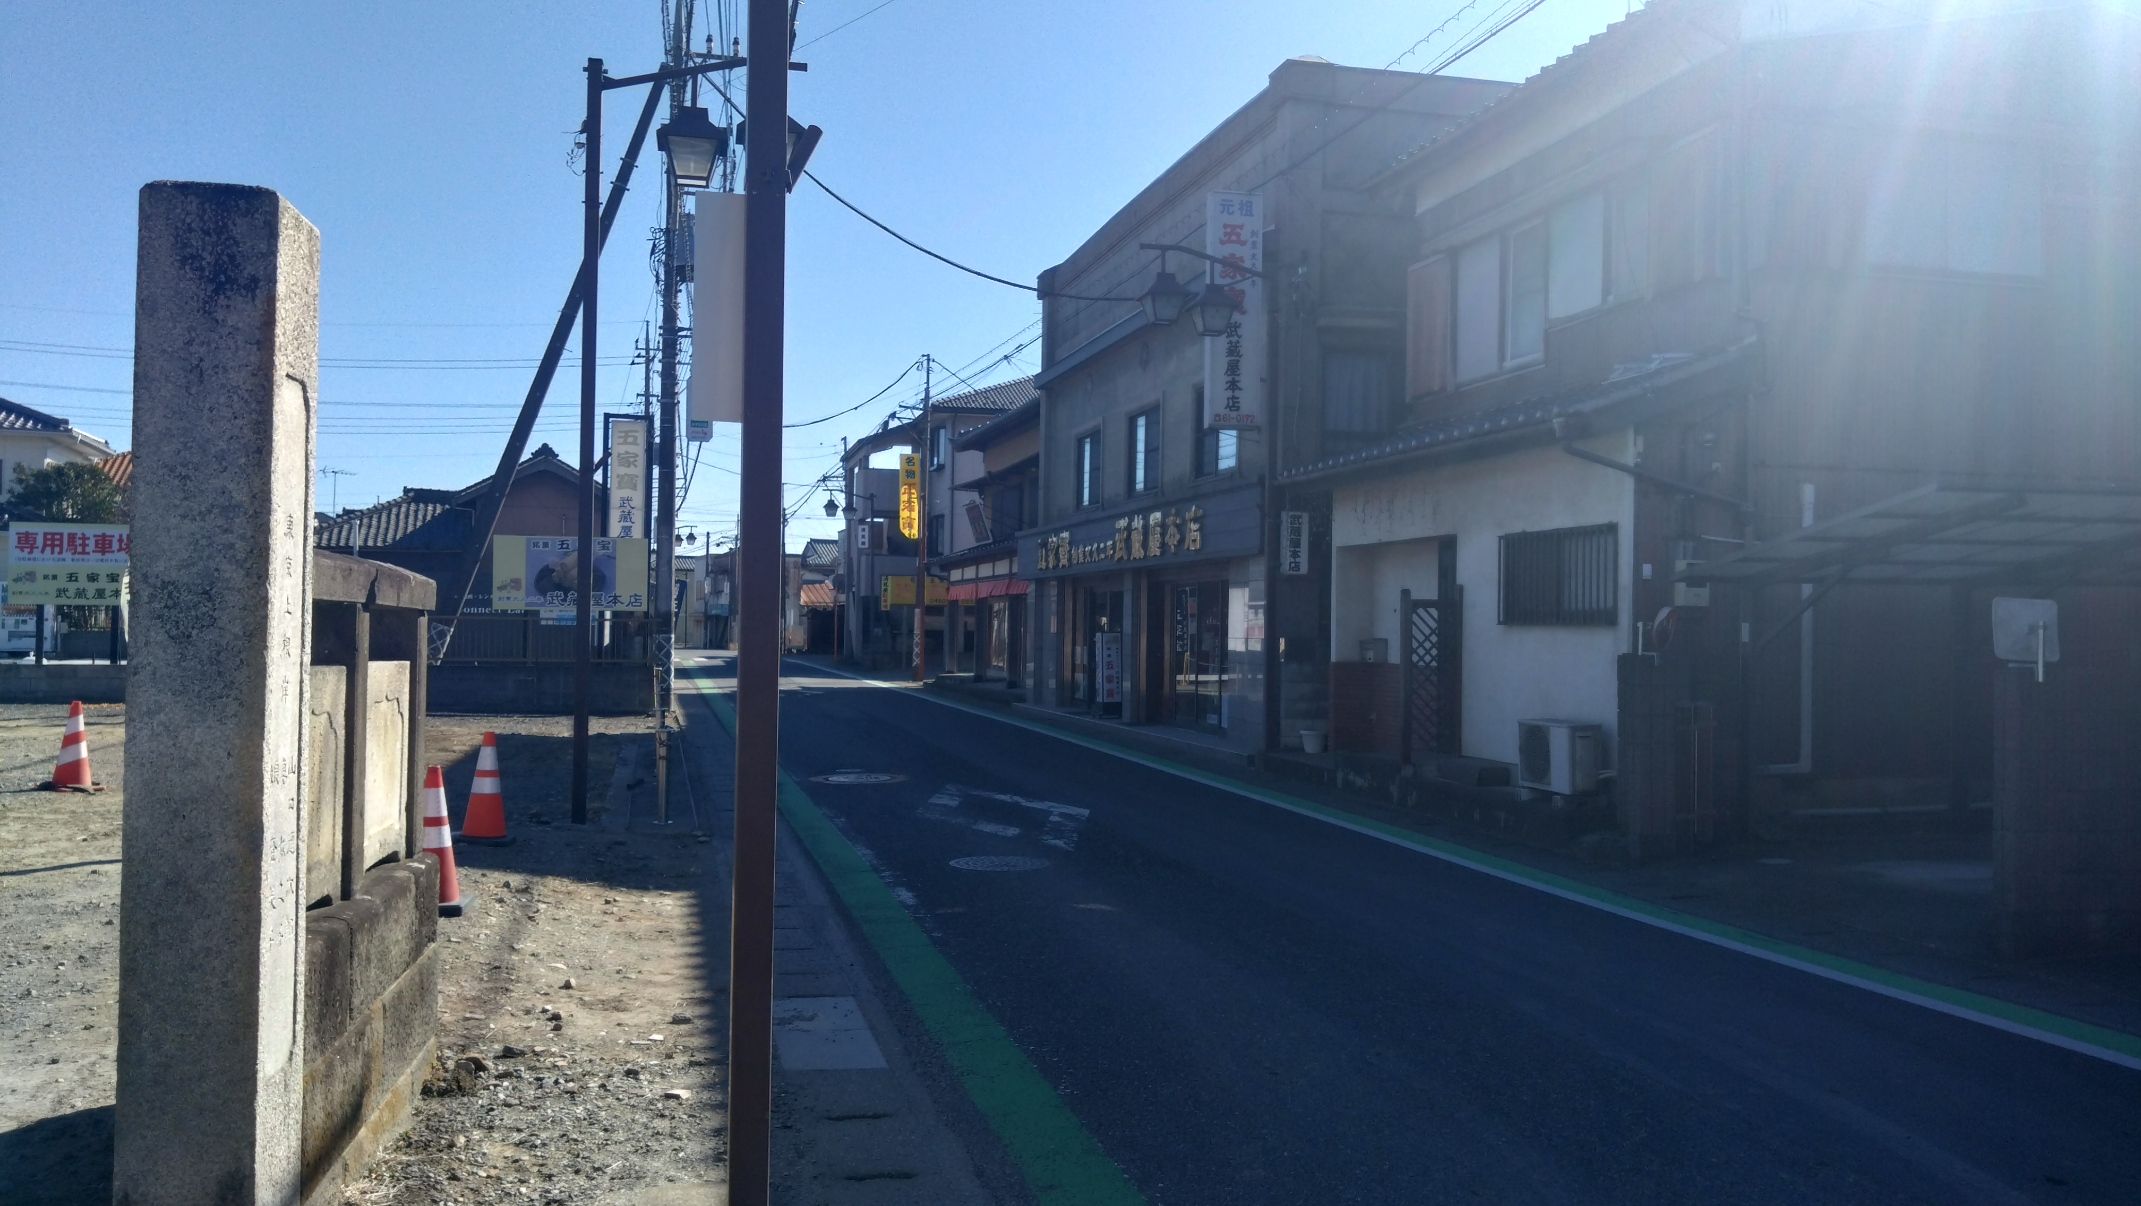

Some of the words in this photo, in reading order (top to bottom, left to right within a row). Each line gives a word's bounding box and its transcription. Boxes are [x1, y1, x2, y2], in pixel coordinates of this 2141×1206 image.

[1219, 198, 1255, 218] 元祖
[1249, 228, 1260, 289] 創業文久年
[1223, 320, 1244, 413] 武蔵屋本店
[1222, 413, 1255, 425] 61-0172
[904, 456, 916, 480] 名物
[556, 539, 612, 551] 五宝
[1114, 504, 1204, 562] 武蔵屋本店
[1288, 513, 1303, 573] 武蔵屋本店
[65, 572, 121, 583] 五家宝
